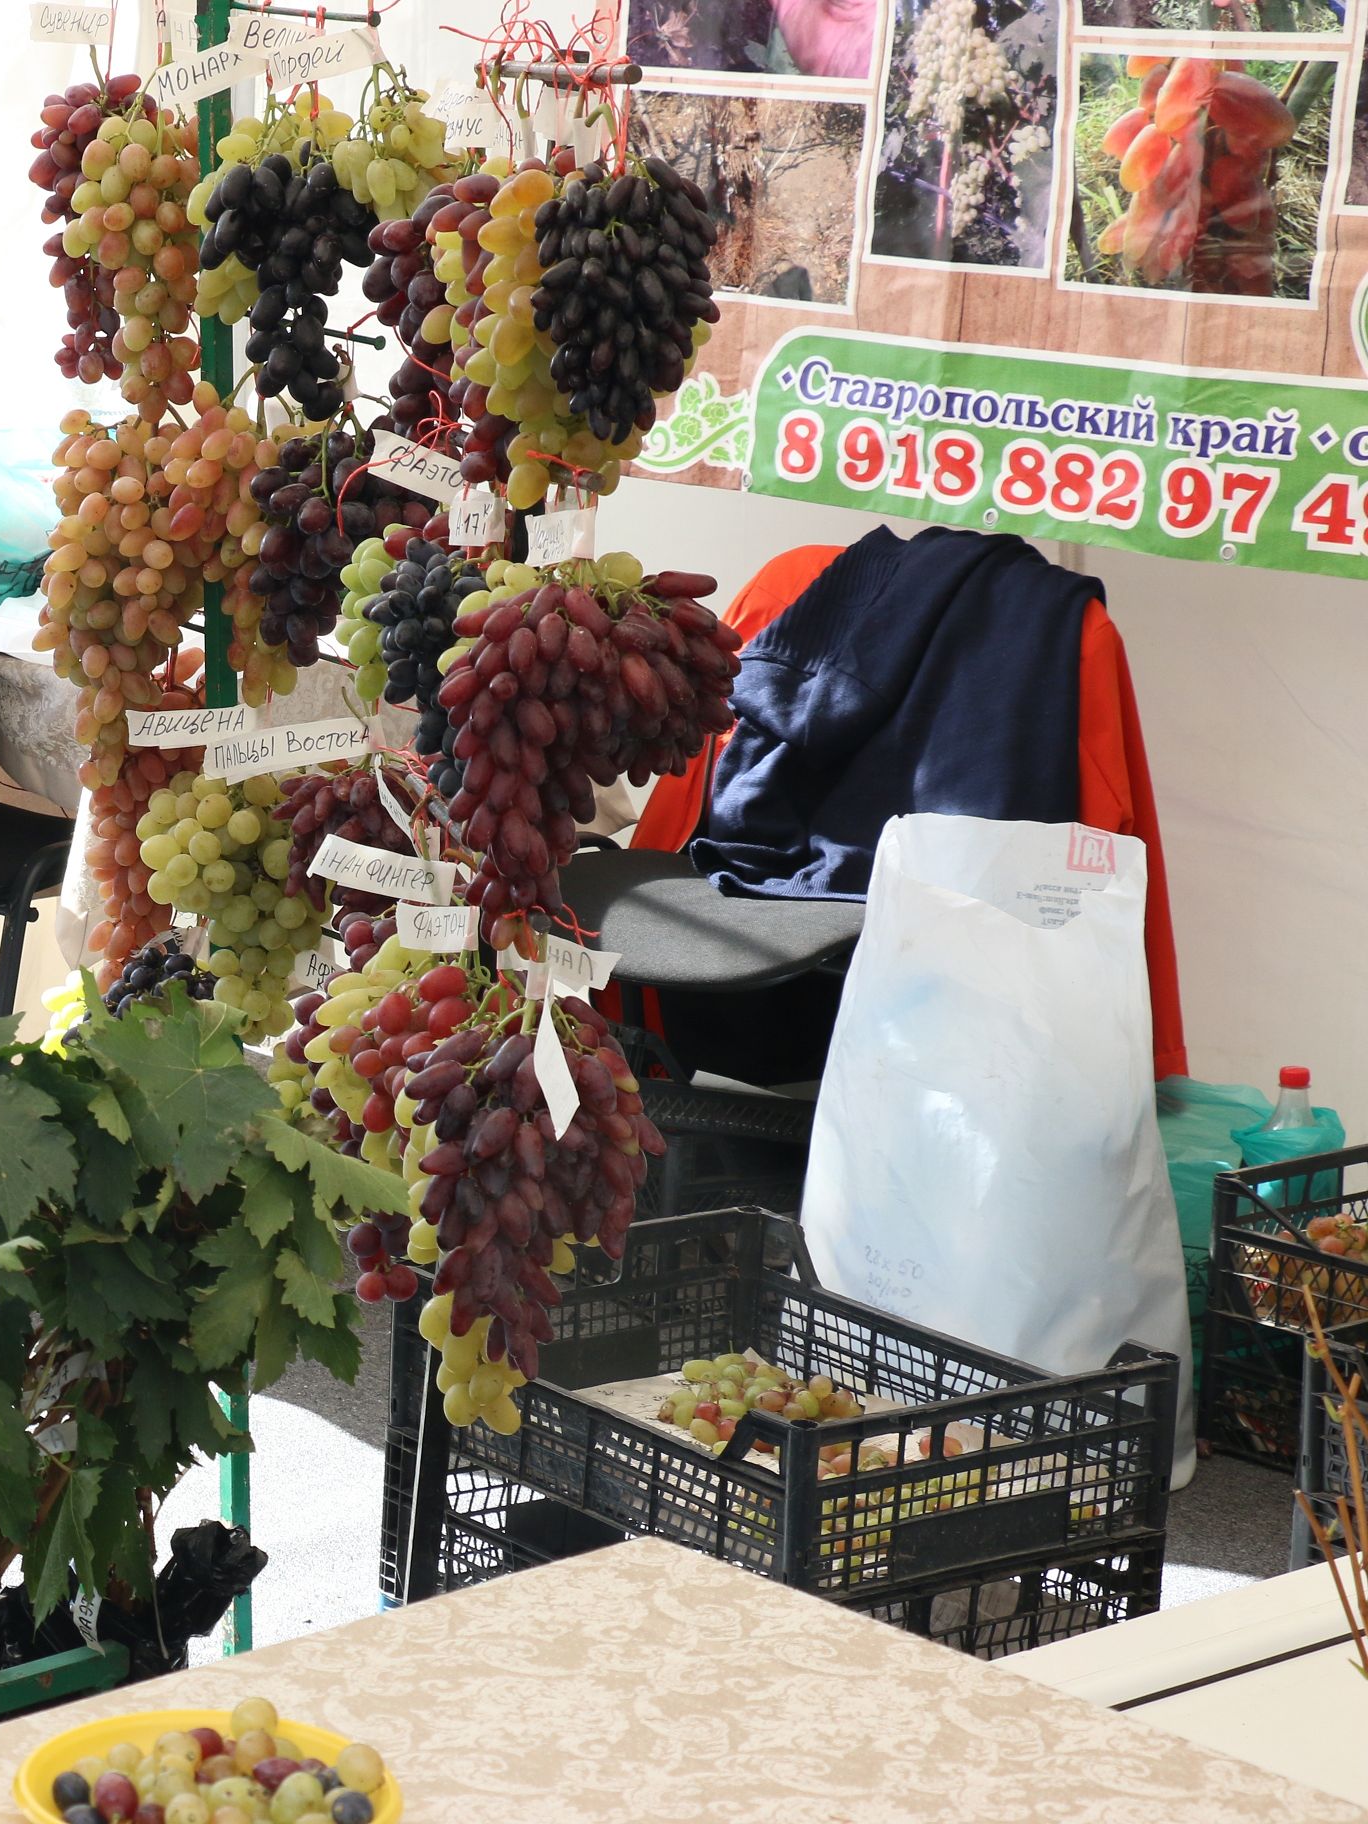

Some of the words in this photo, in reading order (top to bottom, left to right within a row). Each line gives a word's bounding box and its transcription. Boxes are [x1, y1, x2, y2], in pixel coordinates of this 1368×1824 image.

[799, 360, 1155, 442] Ставропольский
[1169, 411, 1296, 458] край
[388, 444, 467, 488] ФАЭТО
[782, 417, 818, 475] 8
[843, 425, 976, 497] 918
[1000, 446, 1140, 522] 882
[1165, 466, 1272, 535] 97
[1302, 482, 1368, 546] 4
